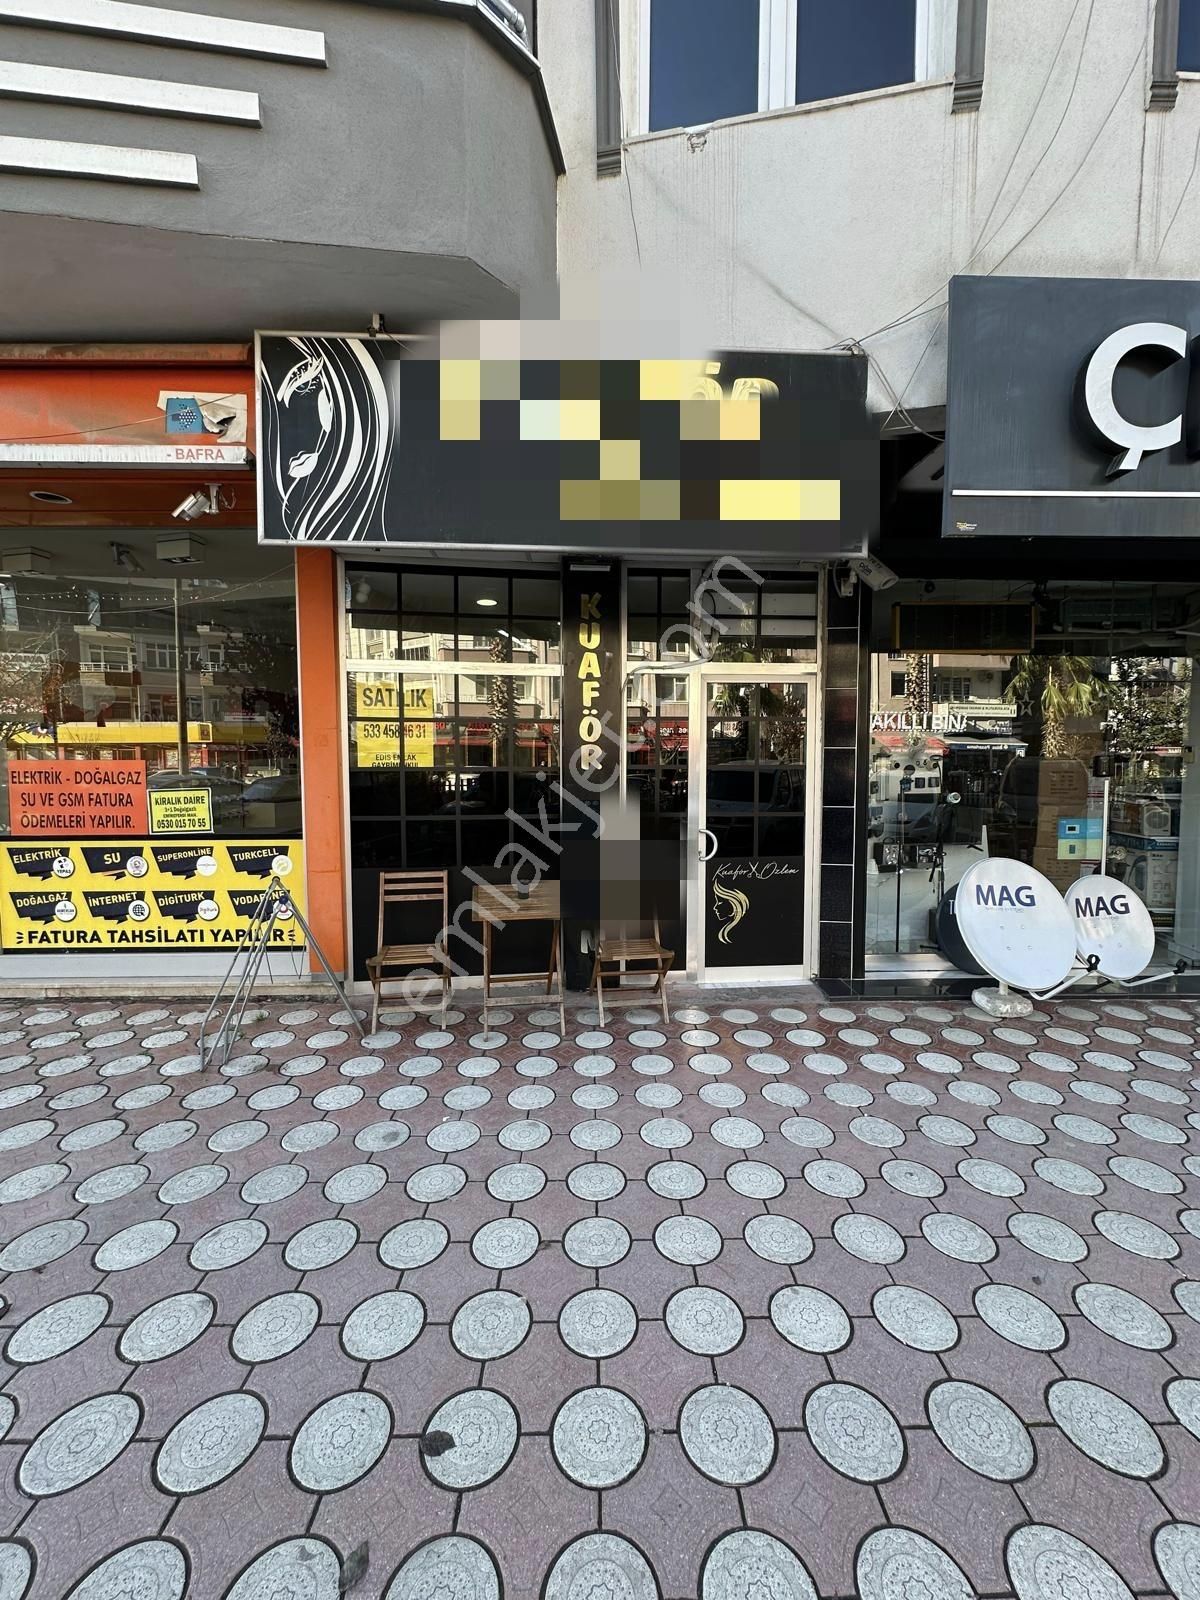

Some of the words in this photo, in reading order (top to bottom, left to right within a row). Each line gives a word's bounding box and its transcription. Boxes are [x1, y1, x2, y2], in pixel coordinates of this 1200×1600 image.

[1086, 322, 1200, 470] Ç
[175, 448, 225, 460] BAFRA
[577, 593, 604, 771] KUAFÖR
[363, 723, 381, 739] 533
[383, 723, 401, 739] 458
[415, 724, 426, 739] 31
[11, 767, 63, 785] ELEKTRİK
[74, 768, 142, 785] DOĞALGAZ
[21, 792, 36, 807] SU
[40, 792, 54, 807] VE
[58, 792, 85, 807] GSM
[88, 793, 134, 807] FATURA
[155, 796, 182, 806] KİRALIK
[184, 795, 205, 804] DAİRE
[20, 811, 86, 829] ÖDEMELERİ
[89, 815, 136, 829] YAPILIR.
[157, 819, 173, 828] 0530
[175, 819, 187, 828] 015
[188, 818, 196, 828] 70
[198, 818, 206, 827] 55
[13, 847, 63, 864] ELEKTRİK
[103, 852, 121, 865] SU
[157, 847, 212, 862] SUPERONLİNE
[233, 847, 280, 862] TURKCELL
[16, 892, 68, 908] DOĞALGAZ
[88, 891, 138, 907] İNTERNET
[158, 891, 205, 907] DİGİTURK
[233, 890, 285, 906] VODAFNE
[975, 884, 1036, 907] MAG
[1074, 894, 1131, 919] MAG
[28, 929, 101, 944] FATURA
[107, 926, 204, 943] TAHSİLATI
[210, 928, 285, 943] YAPILR
